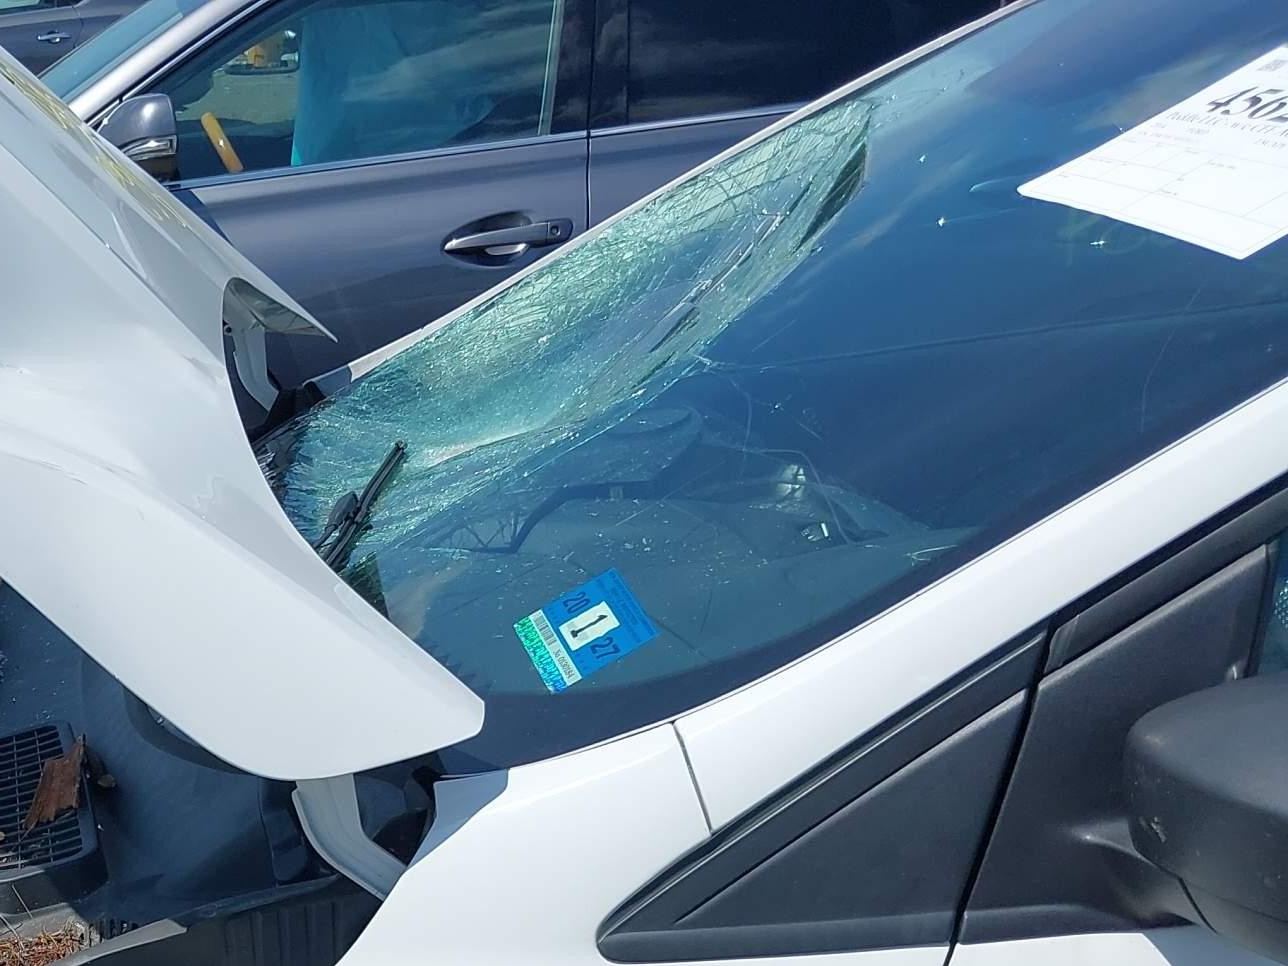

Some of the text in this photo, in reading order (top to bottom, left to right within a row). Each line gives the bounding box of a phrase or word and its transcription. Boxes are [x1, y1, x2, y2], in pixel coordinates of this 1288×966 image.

[563, 591, 621, 660] 20 1 27
